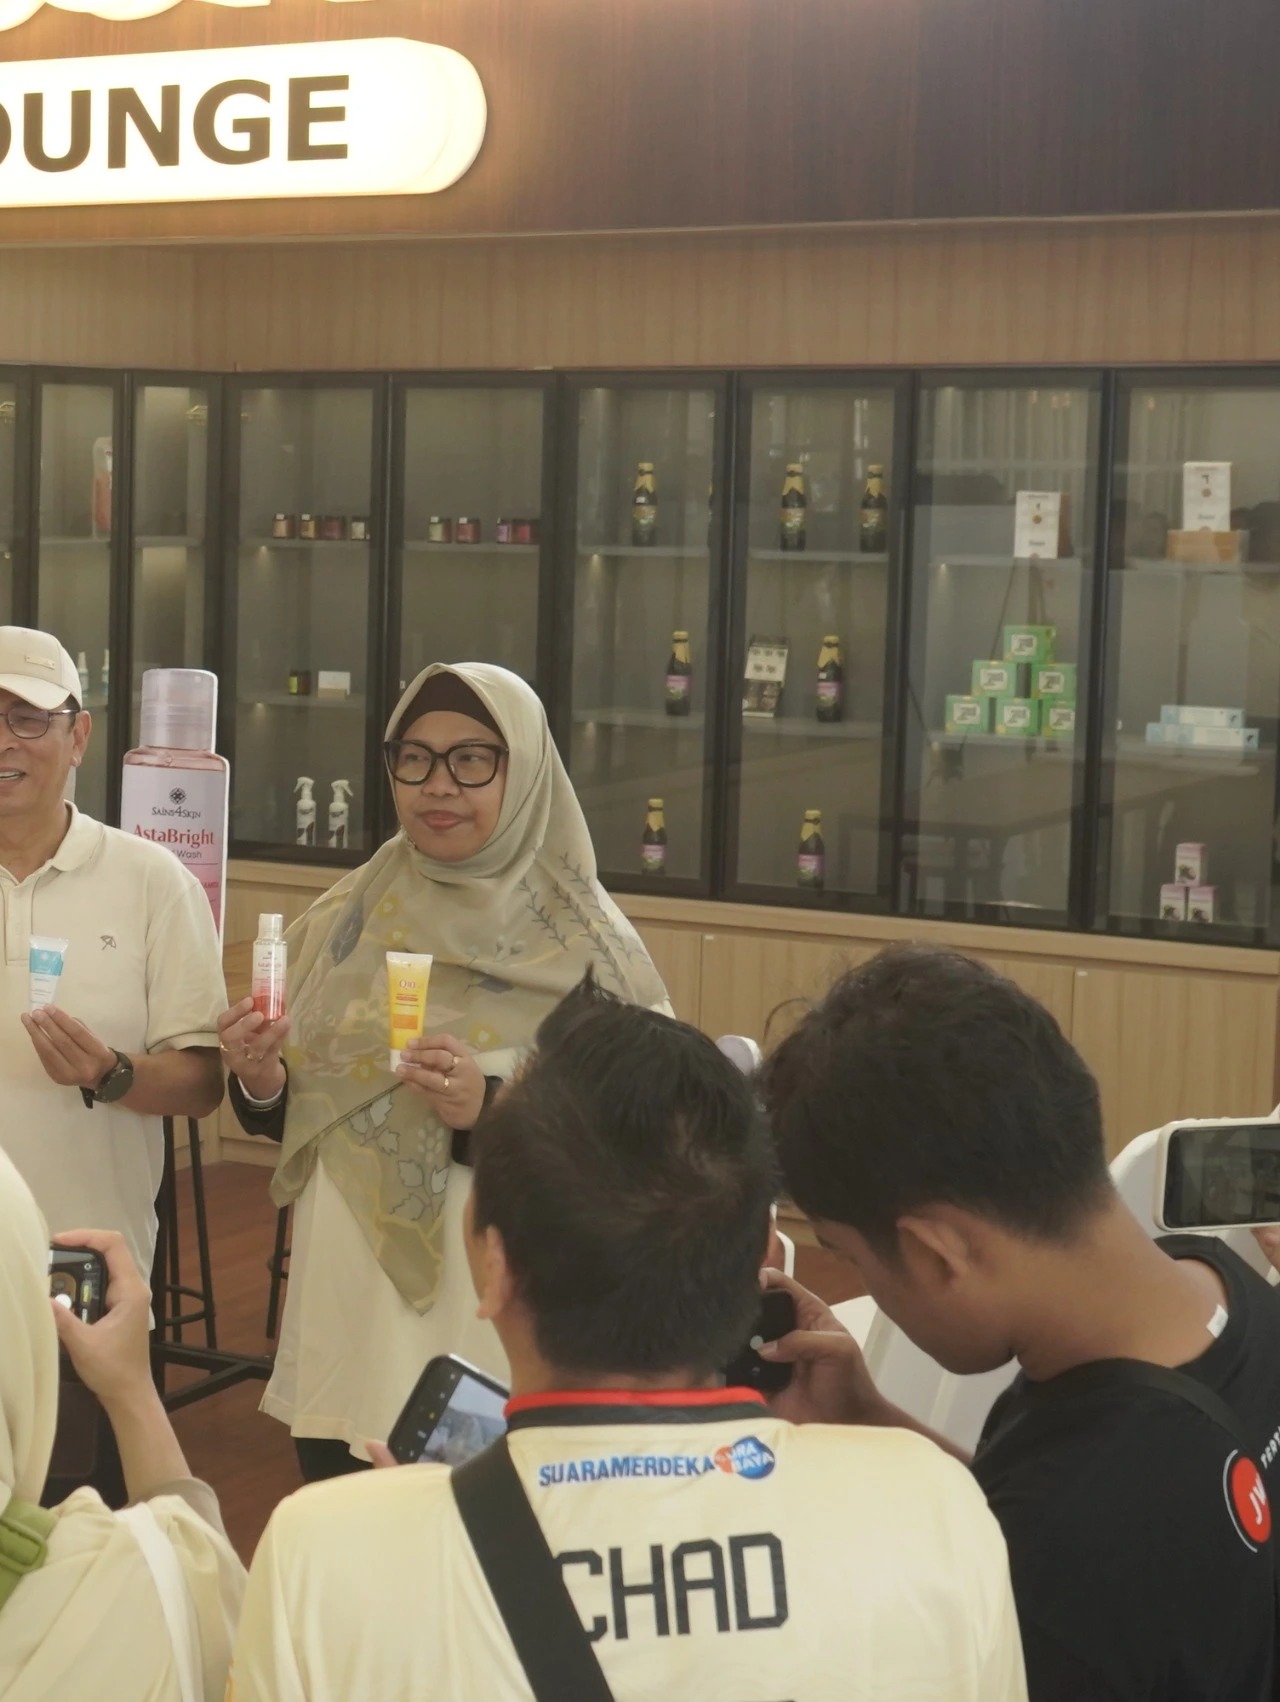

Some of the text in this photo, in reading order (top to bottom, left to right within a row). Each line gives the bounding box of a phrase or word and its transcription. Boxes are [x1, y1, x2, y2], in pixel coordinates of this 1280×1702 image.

[134, 824, 215, 849] AstaBright
[176, 849, 202, 859] Wash
[539, 1455, 716, 1488] SUARAMERDEKA
[554, 1532, 789, 1643] CHAD
